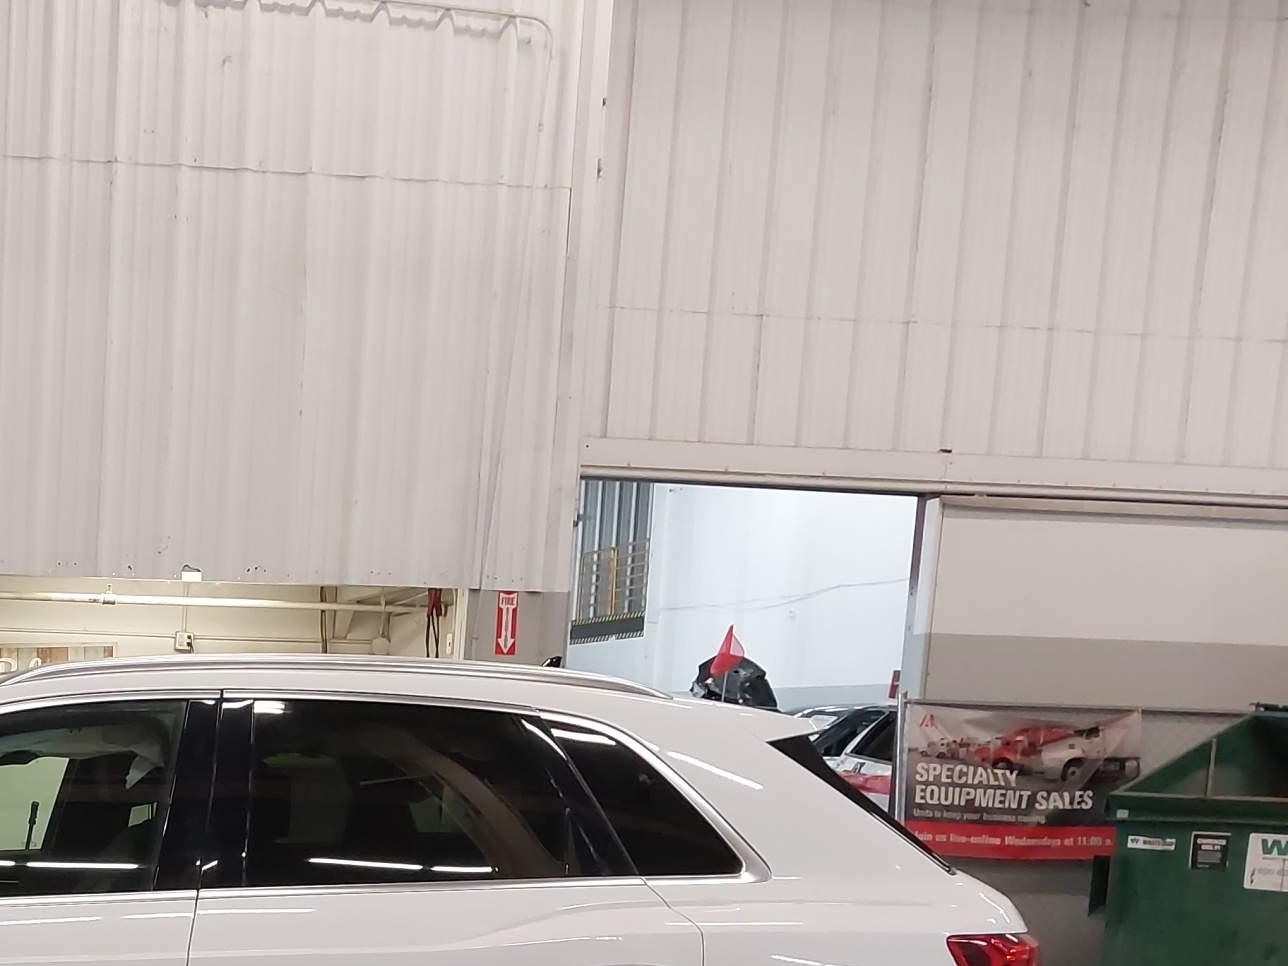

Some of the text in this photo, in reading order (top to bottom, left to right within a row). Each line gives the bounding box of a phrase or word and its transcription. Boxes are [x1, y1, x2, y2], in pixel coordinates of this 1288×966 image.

[915, 763, 1019, 787] SPECIALTY
[914, 785, 1094, 810] EQUIPMENT SALES
